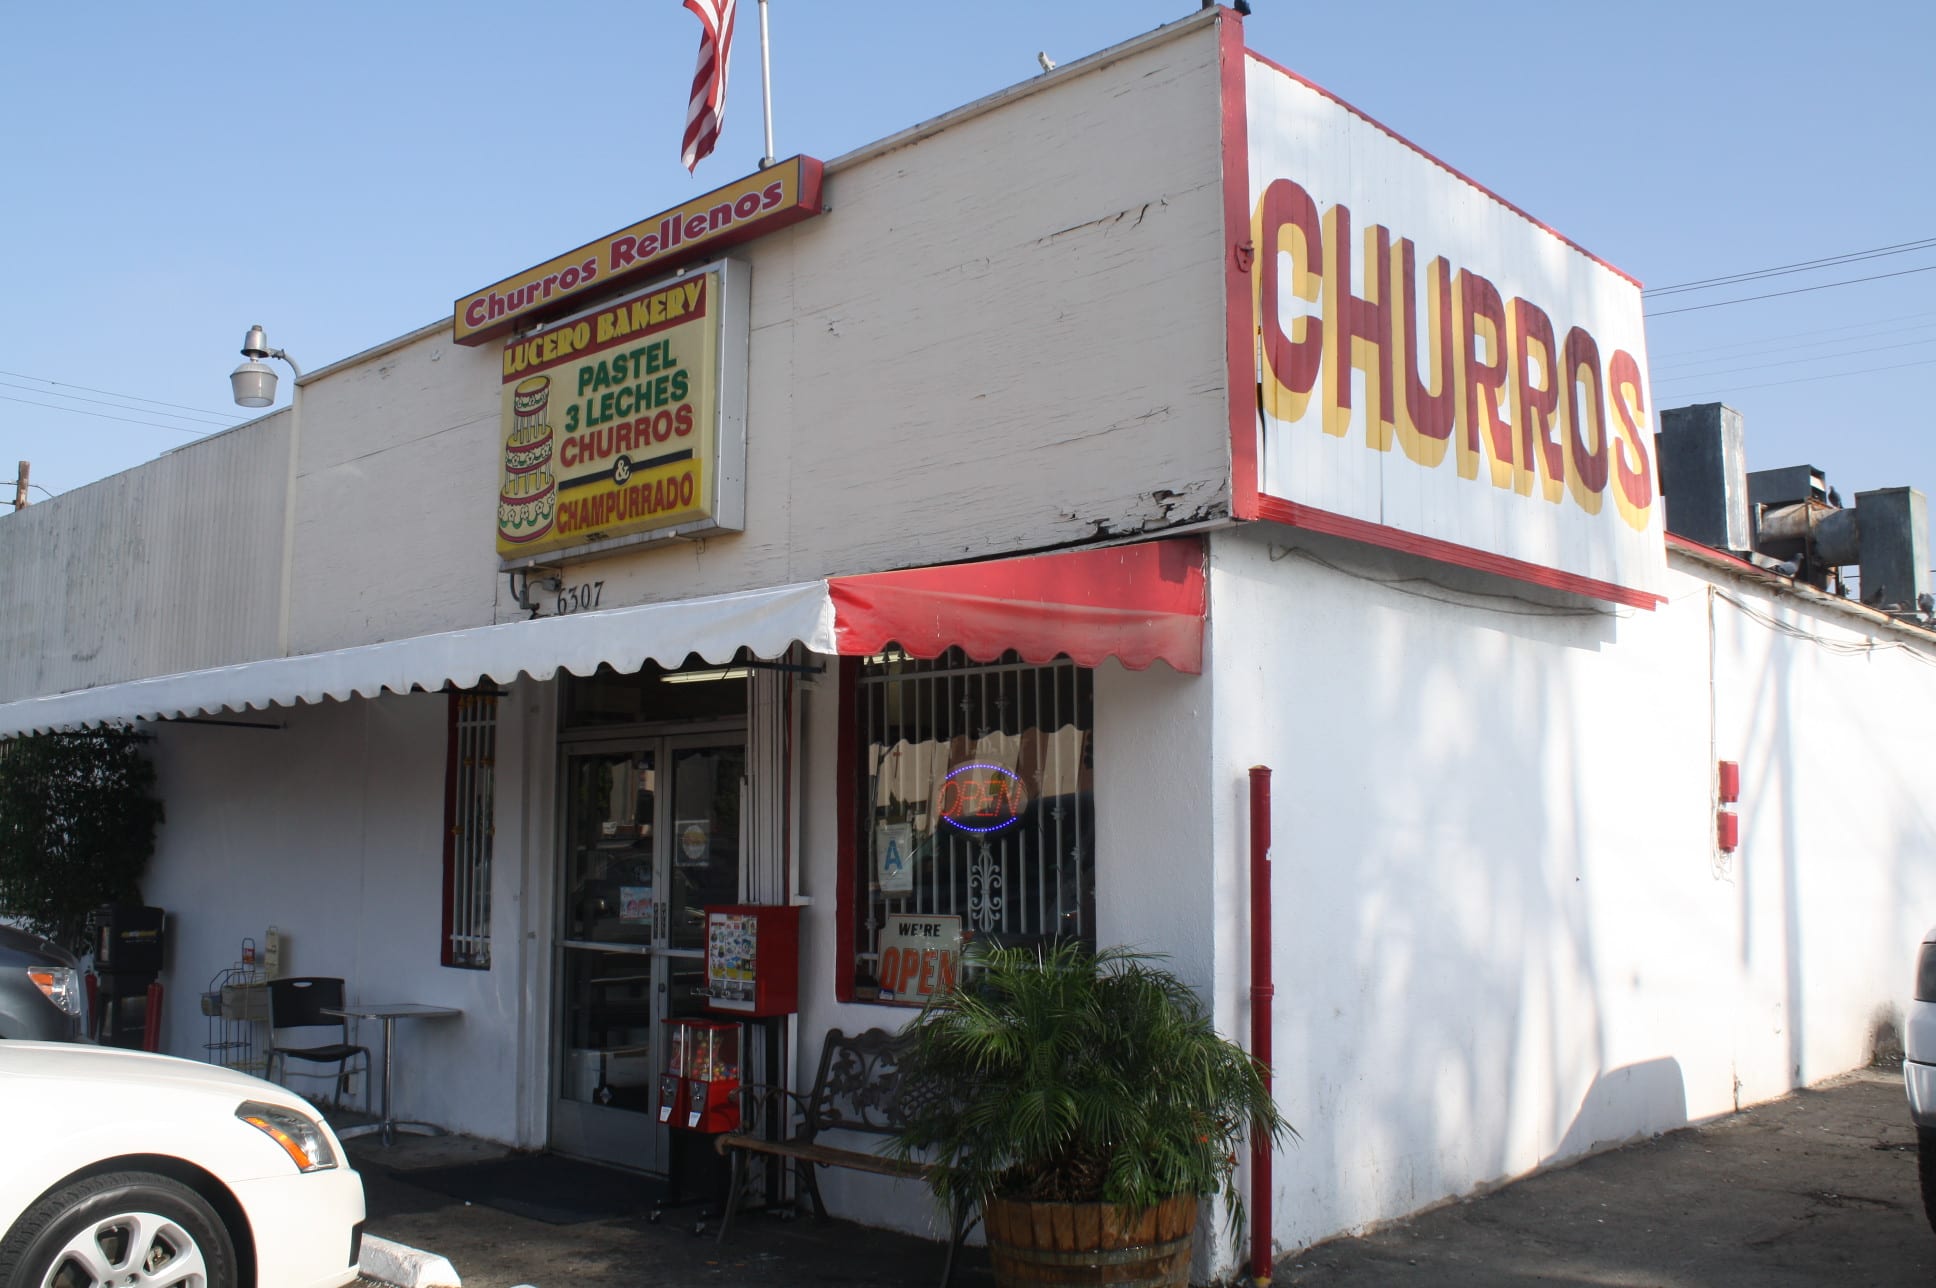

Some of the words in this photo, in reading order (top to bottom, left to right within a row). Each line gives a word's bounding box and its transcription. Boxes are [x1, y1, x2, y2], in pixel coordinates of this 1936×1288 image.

[464, 256, 598, 329] Churros
[609, 179, 784, 272] Rellenos
[503, 321, 591, 376] LUCERO
[596, 279, 704, 344] BAKERY
[1251, 177, 1652, 532] CHURROS
[577, 338, 678, 397] PASTEL
[565, 404, 580, 433] 3
[586, 369, 689, 427] LECHES
[560, 403, 694, 468] CHURROS
[614, 459, 631, 482] &
[556, 471, 694, 534] CHAMPURRADO
[557, 580, 605, 616] 6307
[937, 780, 1023, 817] OPEN
[884, 839, 903, 871] A
[898, 922, 941, 937] WE'RE
[880, 946, 958, 995] OPEN
